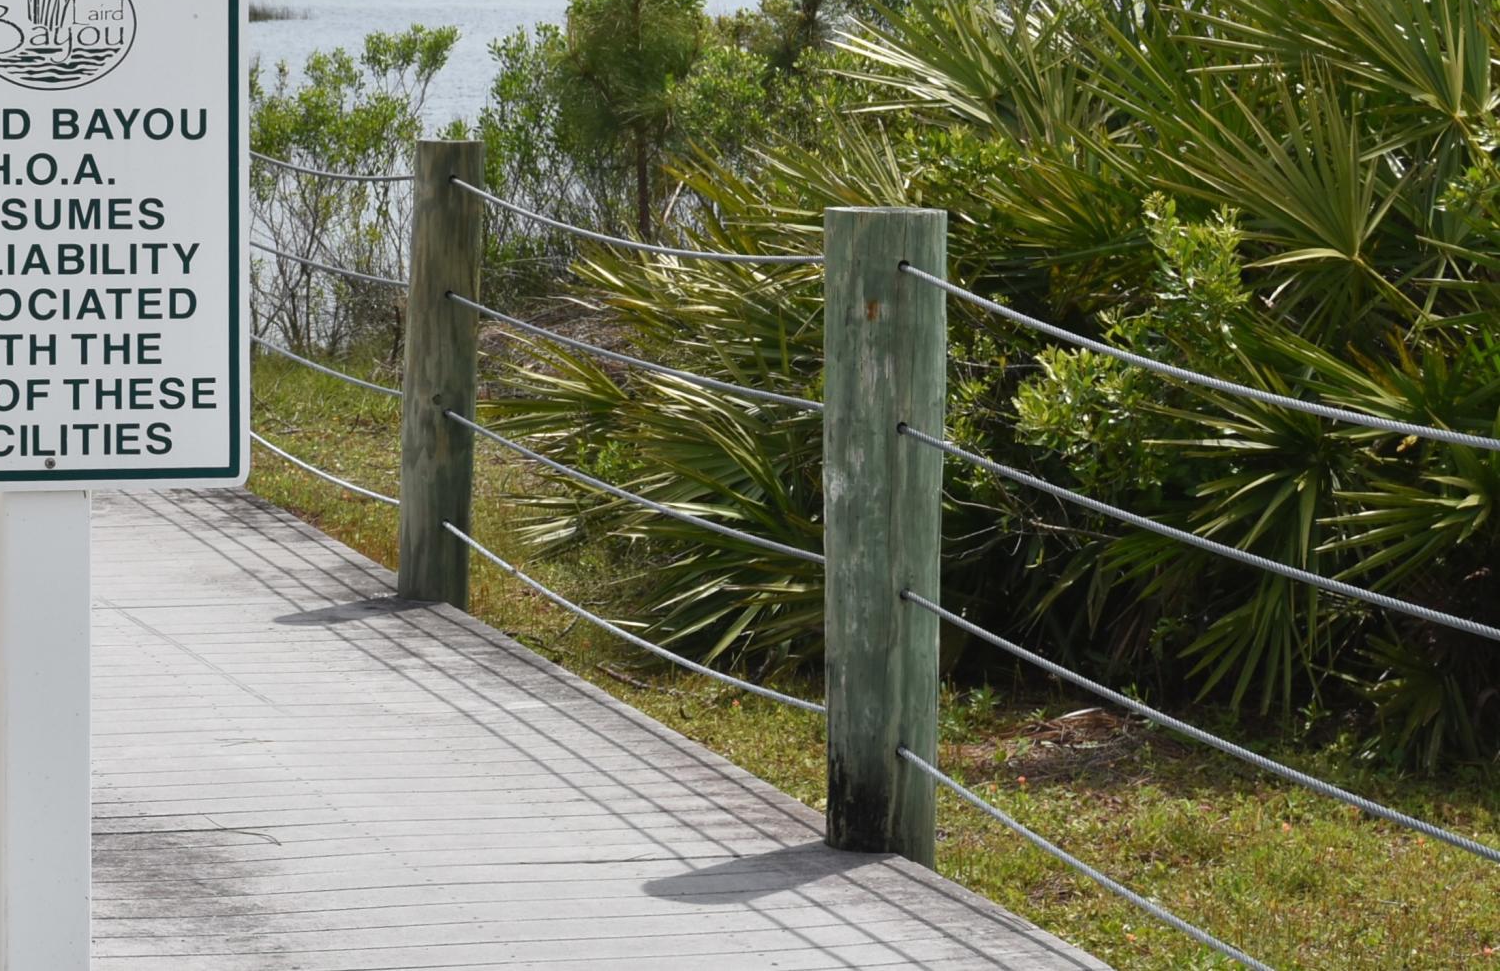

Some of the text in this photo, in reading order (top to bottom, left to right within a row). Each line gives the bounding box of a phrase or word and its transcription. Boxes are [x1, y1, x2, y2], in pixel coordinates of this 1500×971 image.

[53, 108, 206, 140] BAYOU
[71, 333, 161, 364] THE
[63, 378, 216, 410] THESE
